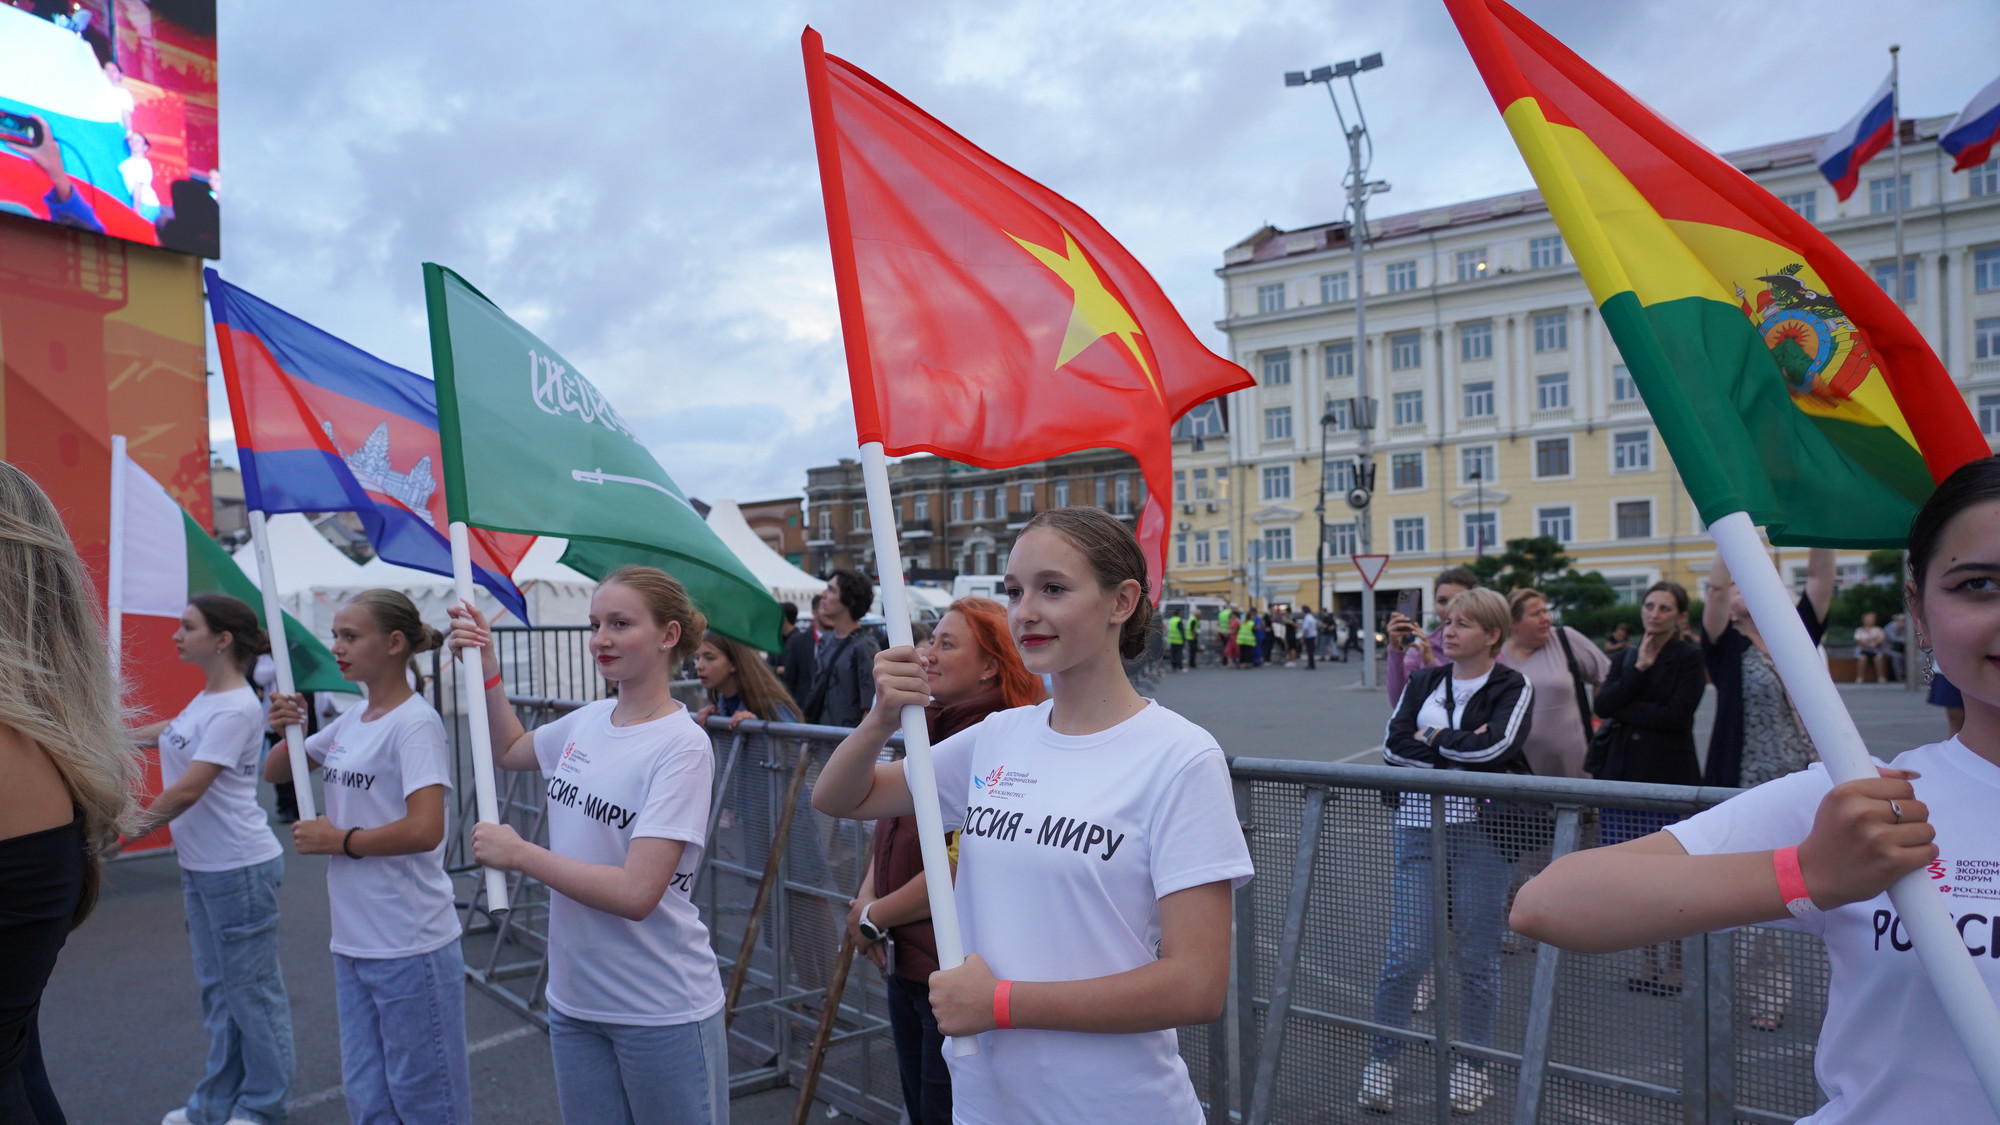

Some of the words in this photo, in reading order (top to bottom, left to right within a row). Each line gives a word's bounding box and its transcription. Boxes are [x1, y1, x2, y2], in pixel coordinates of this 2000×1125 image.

[1759, 309, 1830, 346] BOLIVIA
[547, 776, 579, 809] СИЯ
[584, 793, 637, 830] МИРУ
[1037, 815, 1125, 861] МИРУ
[1954, 875, 1992, 883] ФОРУМ
[1955, 867, 2000, 876] ЭКОНОМ
